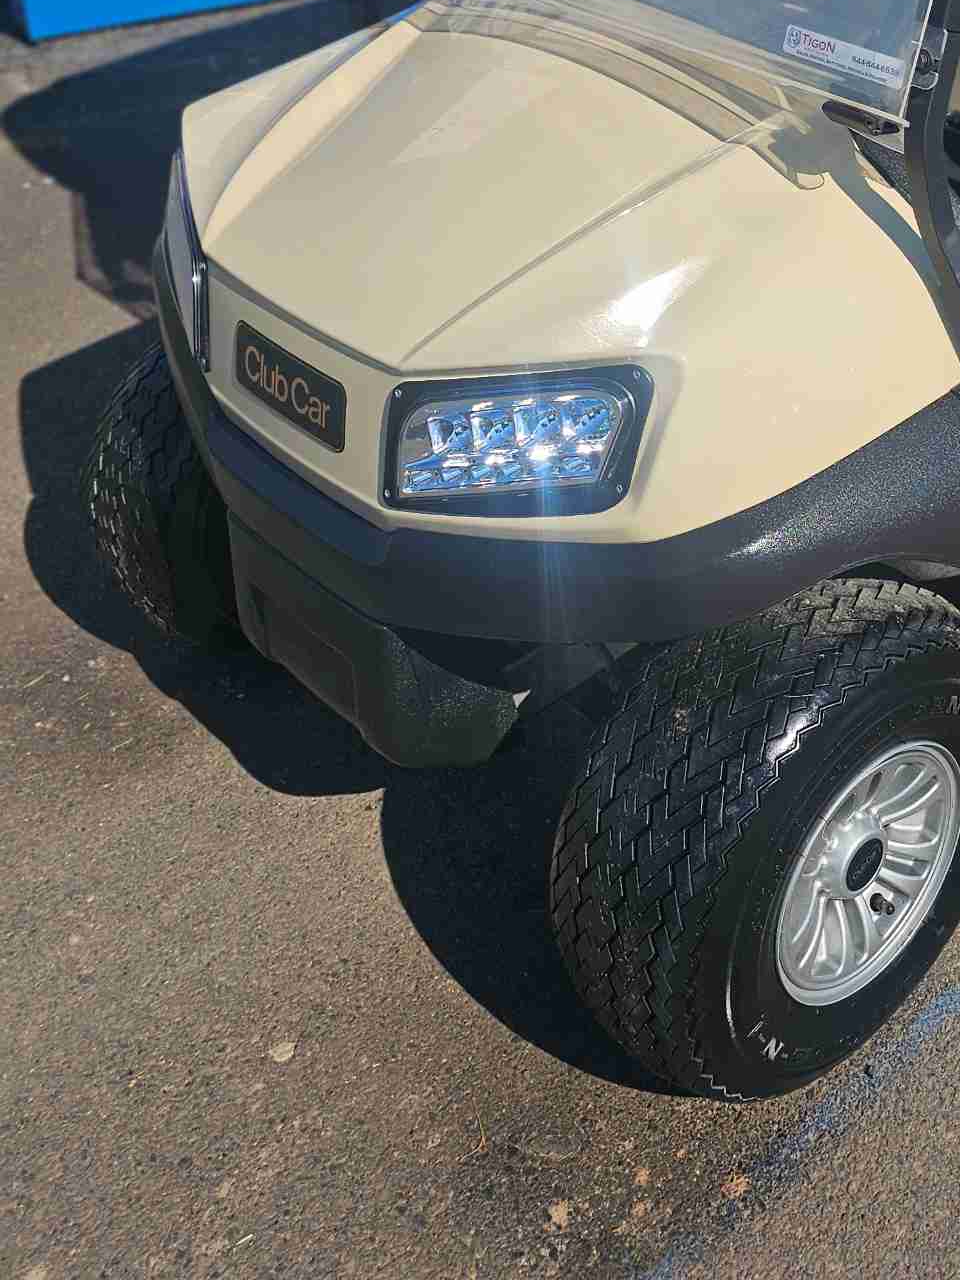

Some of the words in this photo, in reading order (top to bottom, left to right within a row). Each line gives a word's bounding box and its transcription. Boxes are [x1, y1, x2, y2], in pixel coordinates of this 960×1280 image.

[801, 33, 836, 55] TIGON
[244, 345, 289, 403] Club
[291, 377, 331, 430] Car
